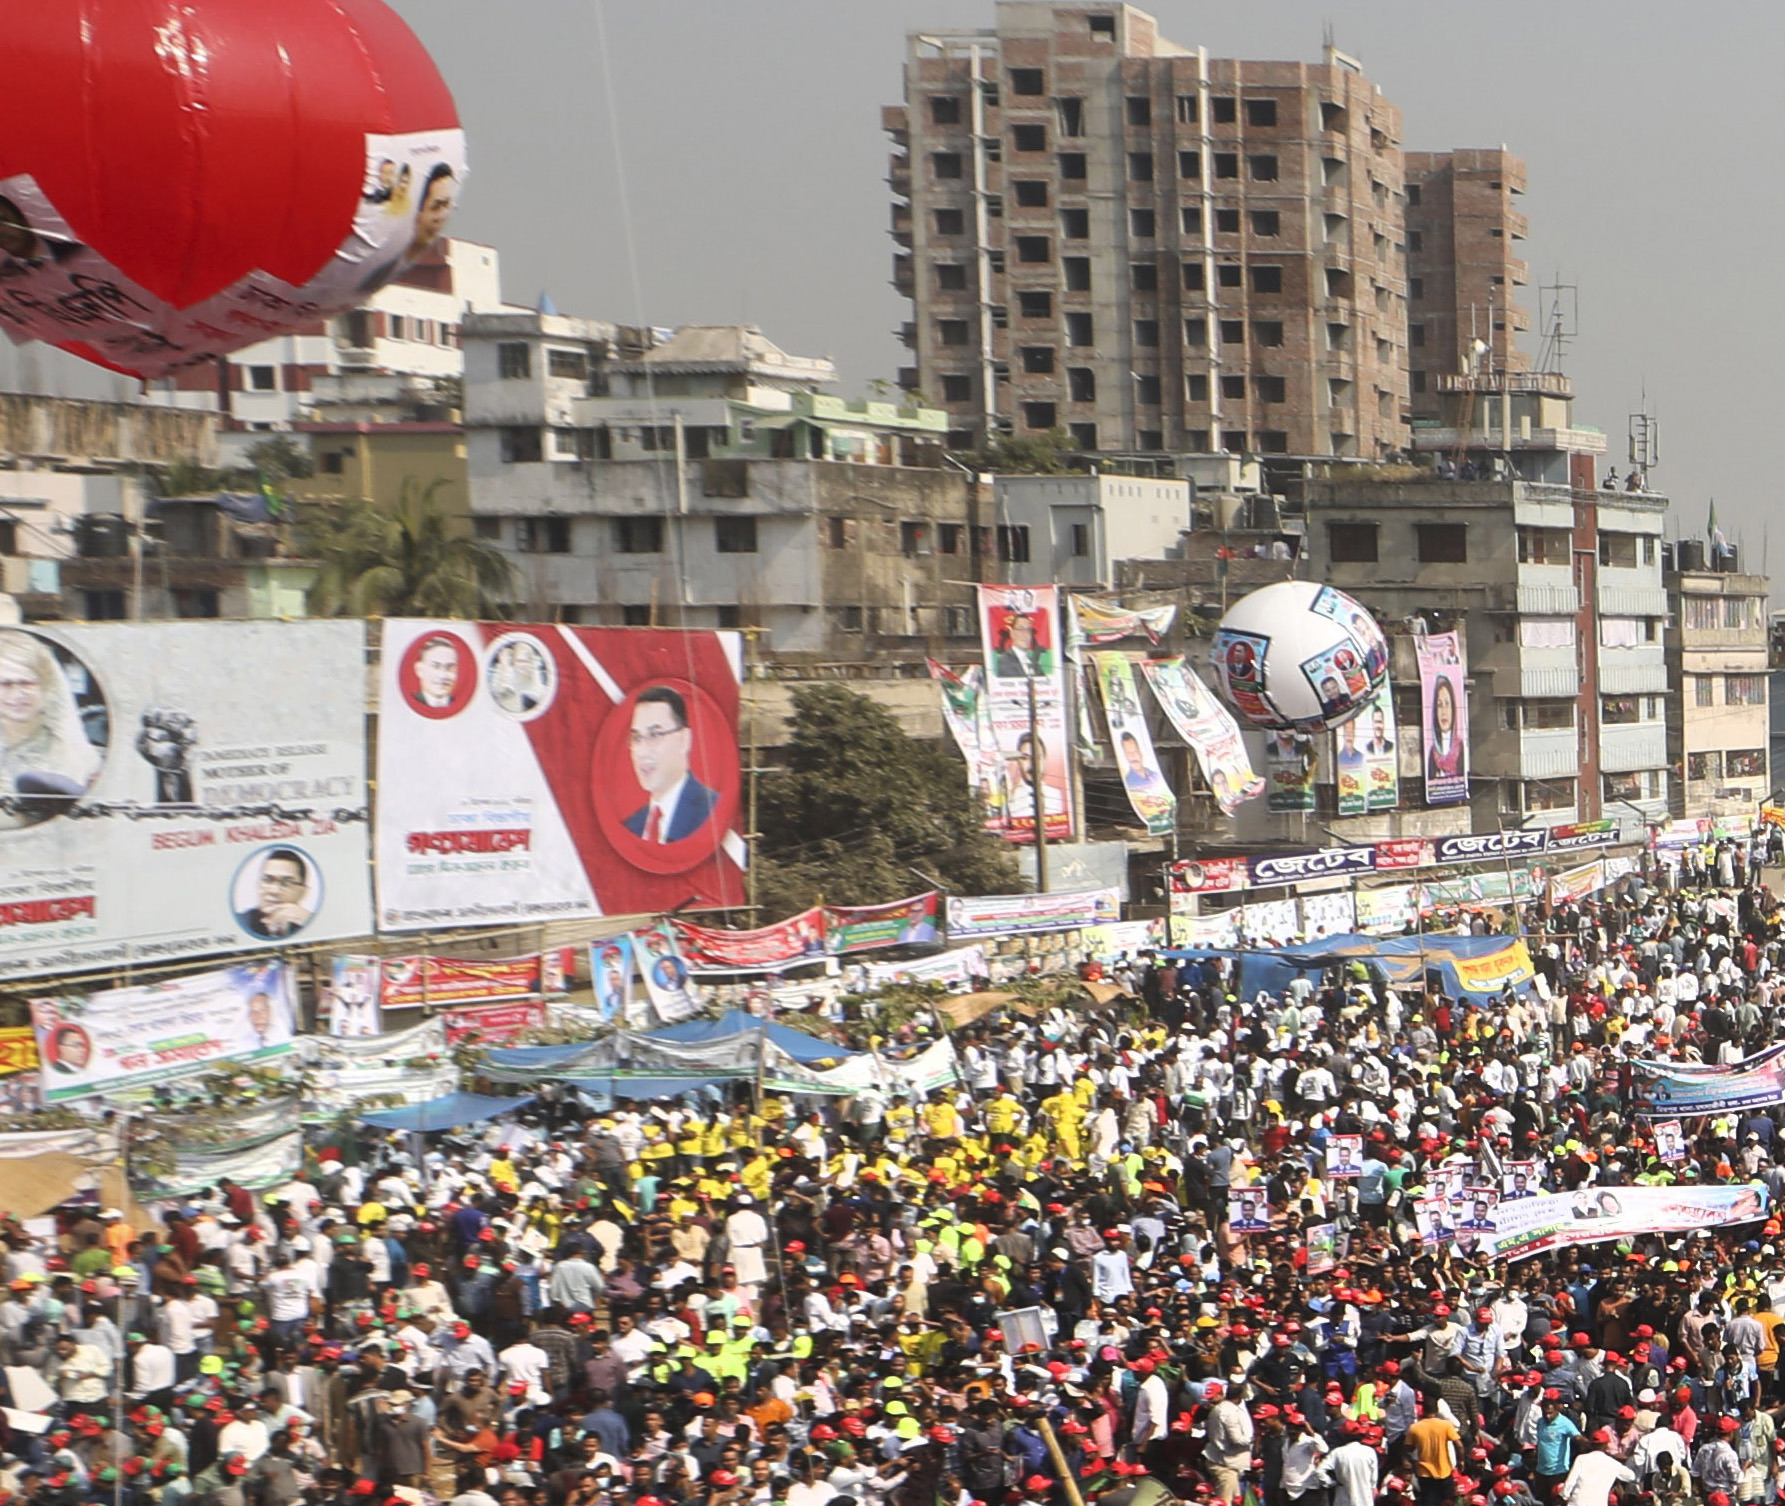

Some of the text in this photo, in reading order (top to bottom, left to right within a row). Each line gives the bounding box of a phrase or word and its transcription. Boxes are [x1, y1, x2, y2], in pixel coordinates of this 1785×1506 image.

[269, 762, 291, 775] OF
[201, 776, 356, 802] DEMOCRACY
[151, 830, 216, 850] BEGUM
[226, 821, 303, 843] KHALEDA
[1441, 830, 1545, 856] জেটেব
[1255, 847, 1375, 878] জেটেব
